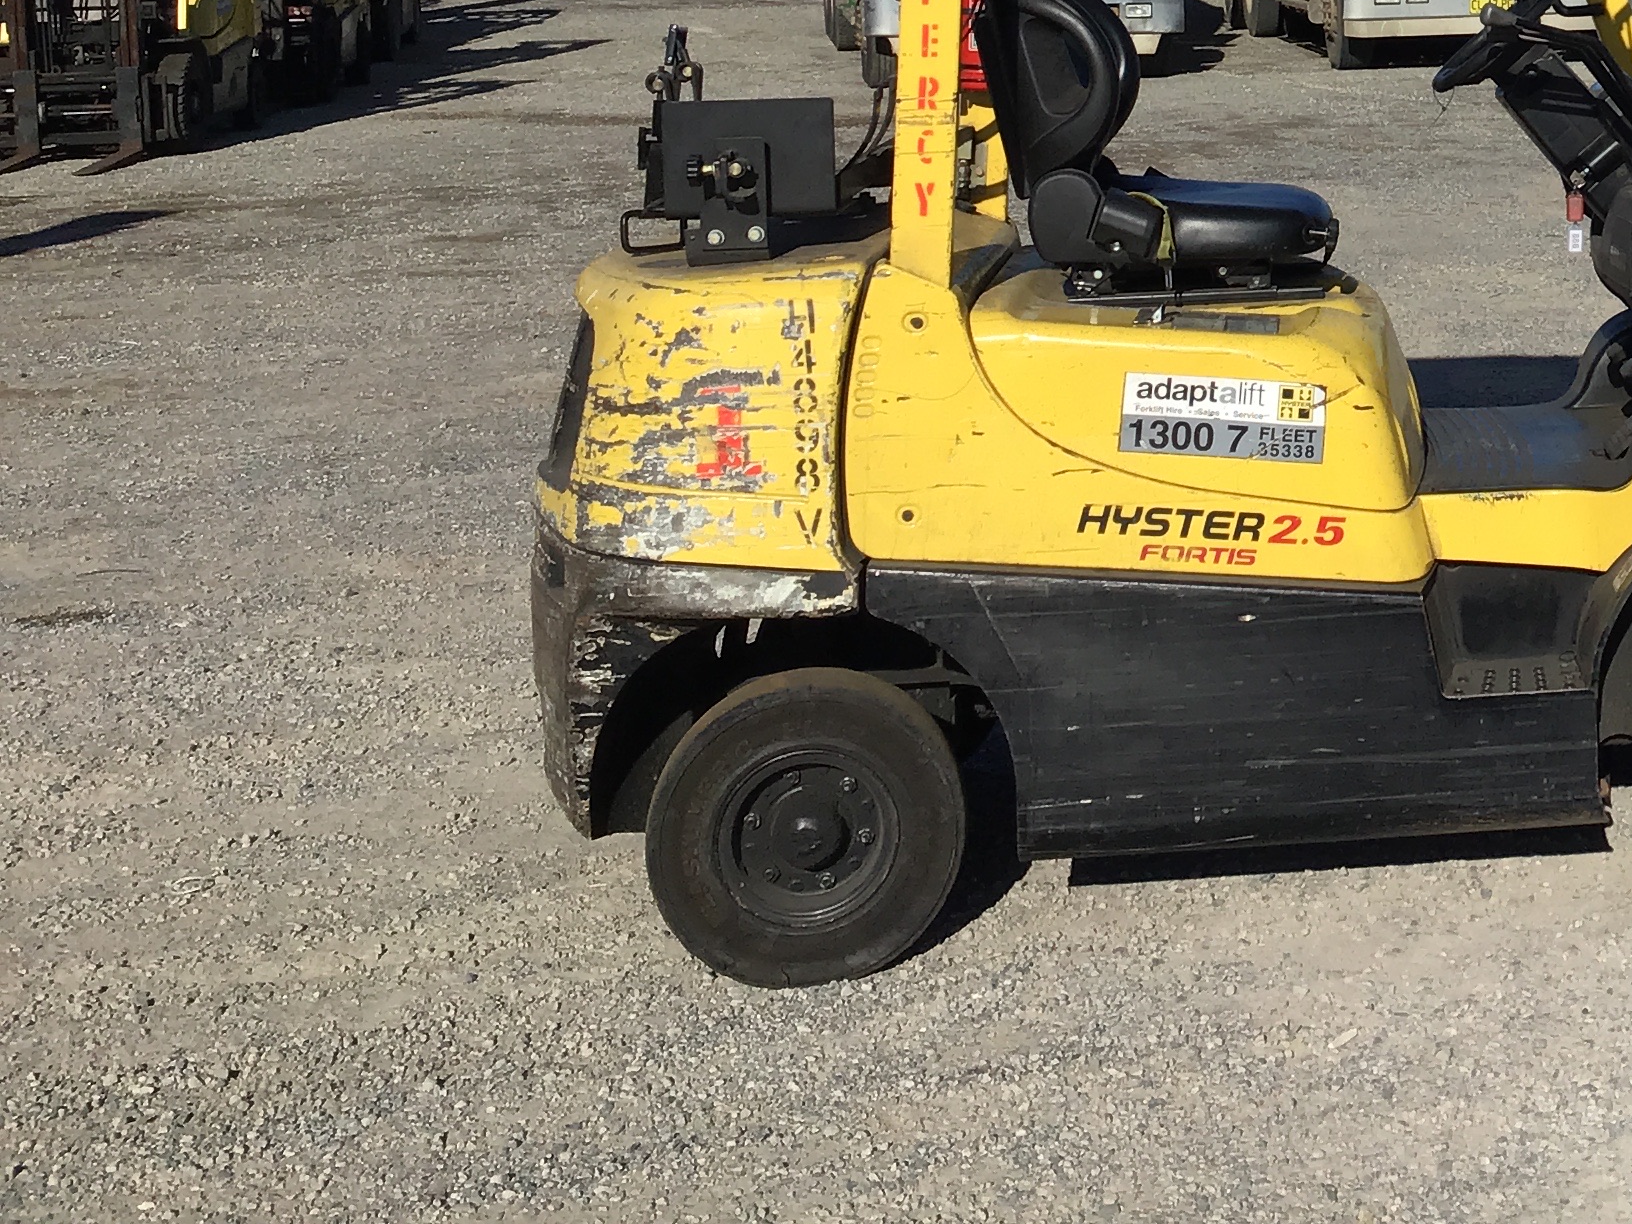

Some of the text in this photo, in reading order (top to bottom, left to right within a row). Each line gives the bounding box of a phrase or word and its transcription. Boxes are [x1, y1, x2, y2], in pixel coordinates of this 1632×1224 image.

[1136, 377, 1266, 407] adaptalift
[1134, 404, 1164, 415] Forklift
[1166, 407, 1183, 415] Hire
[1232, 410, 1264, 420] Service
[1128, 418, 1249, 454] 1300 7
[1258, 426, 1318, 444] FLEET
[1256, 441, 1316, 459] 35338
[1076, 503, 1347, 546] HYSTER 2.5
[1139, 544, 1258, 566] FORTIS
